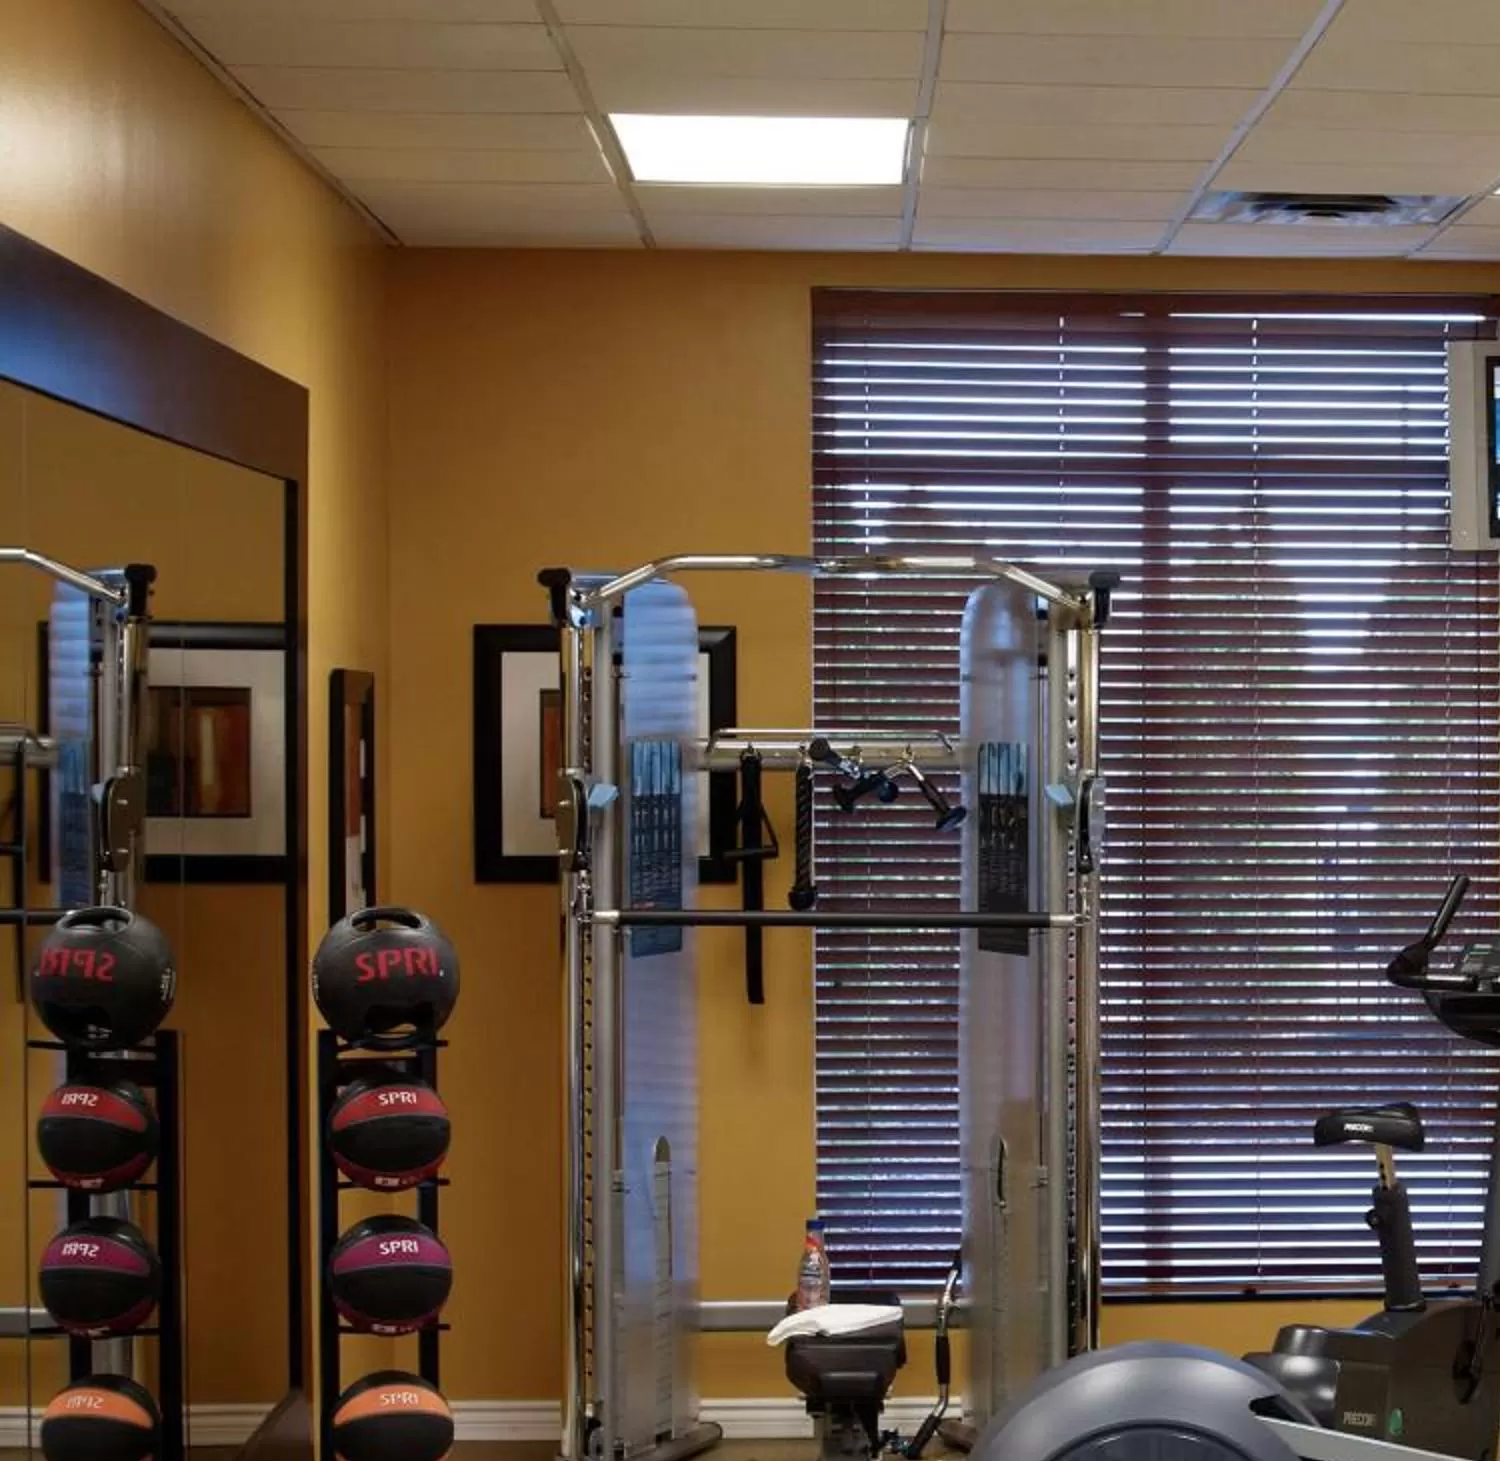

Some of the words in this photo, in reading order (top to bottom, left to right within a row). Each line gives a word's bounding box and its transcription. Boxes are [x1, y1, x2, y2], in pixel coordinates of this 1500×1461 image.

[355, 947, 439, 981] SPRI
[378, 1091, 417, 1107] SPRI
[379, 1240, 419, 1255] SPRI
